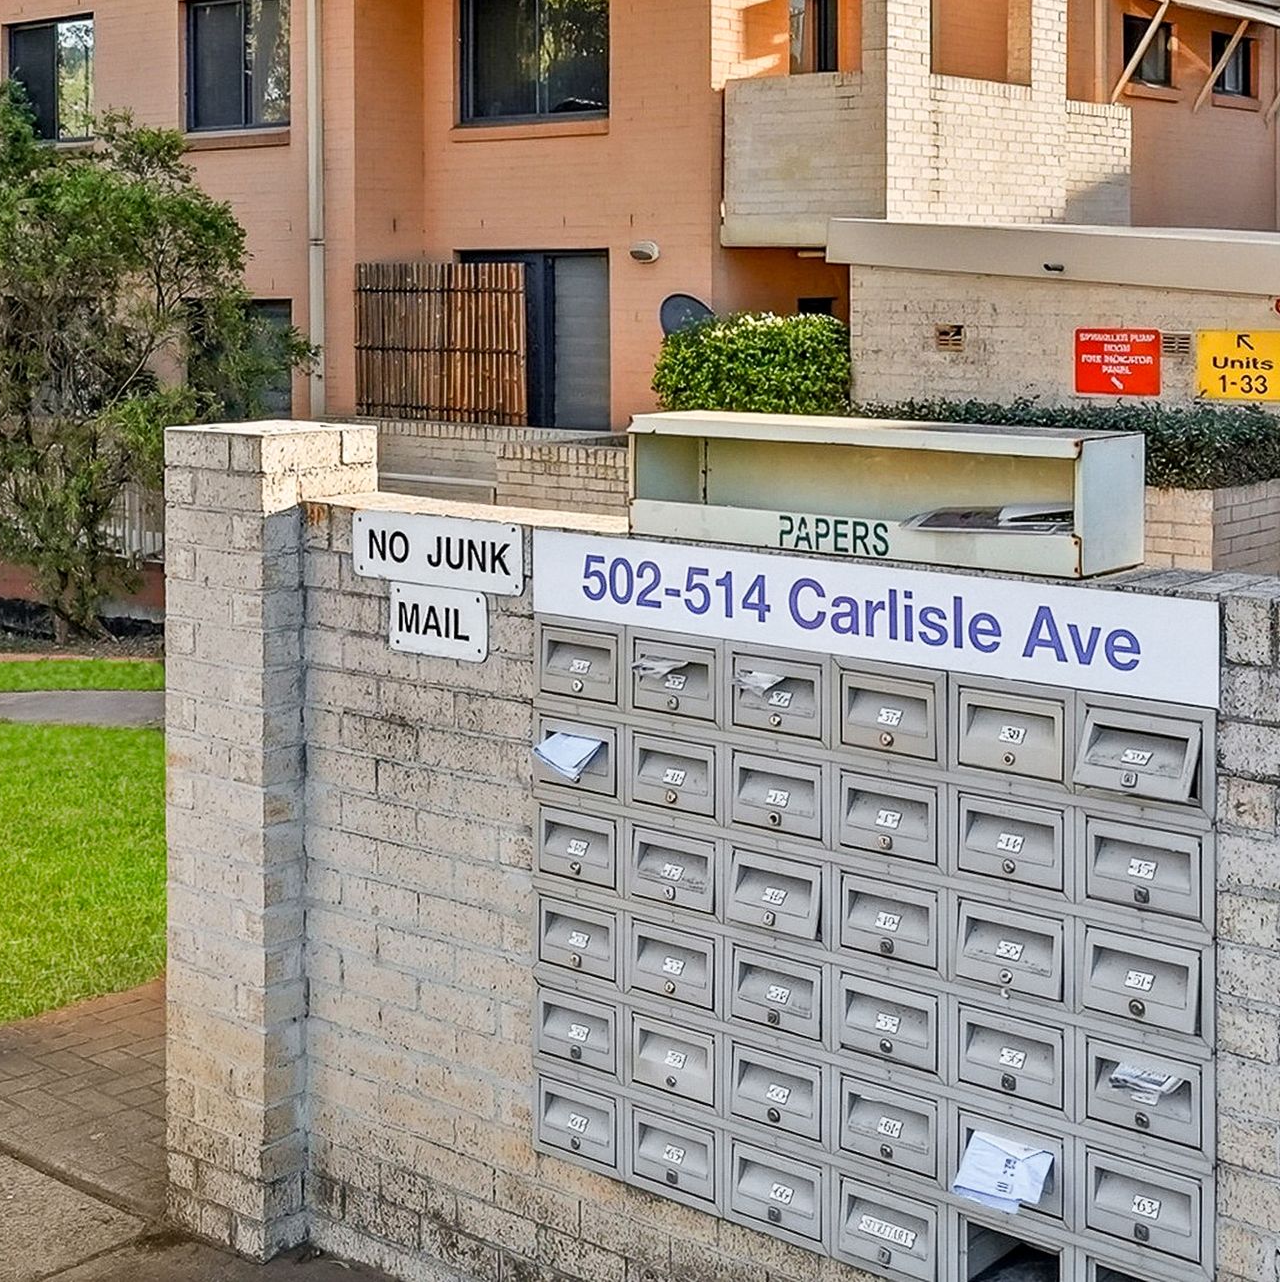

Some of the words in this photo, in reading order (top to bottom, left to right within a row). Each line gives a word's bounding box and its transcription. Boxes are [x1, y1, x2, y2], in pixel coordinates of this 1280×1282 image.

[1212, 356, 1274, 371] Units
[1218, 374, 1269, 395] 1-33
[368, 528, 410, 564] NO
[426, 536, 512, 576] JUNK
[779, 515, 890, 557] PAPERS
[398, 601, 470, 642] MAIL
[583, 554, 771, 623] 502-514
[788, 577, 1002, 654] Carlisle
[1023, 605, 1142, 671] Ave
